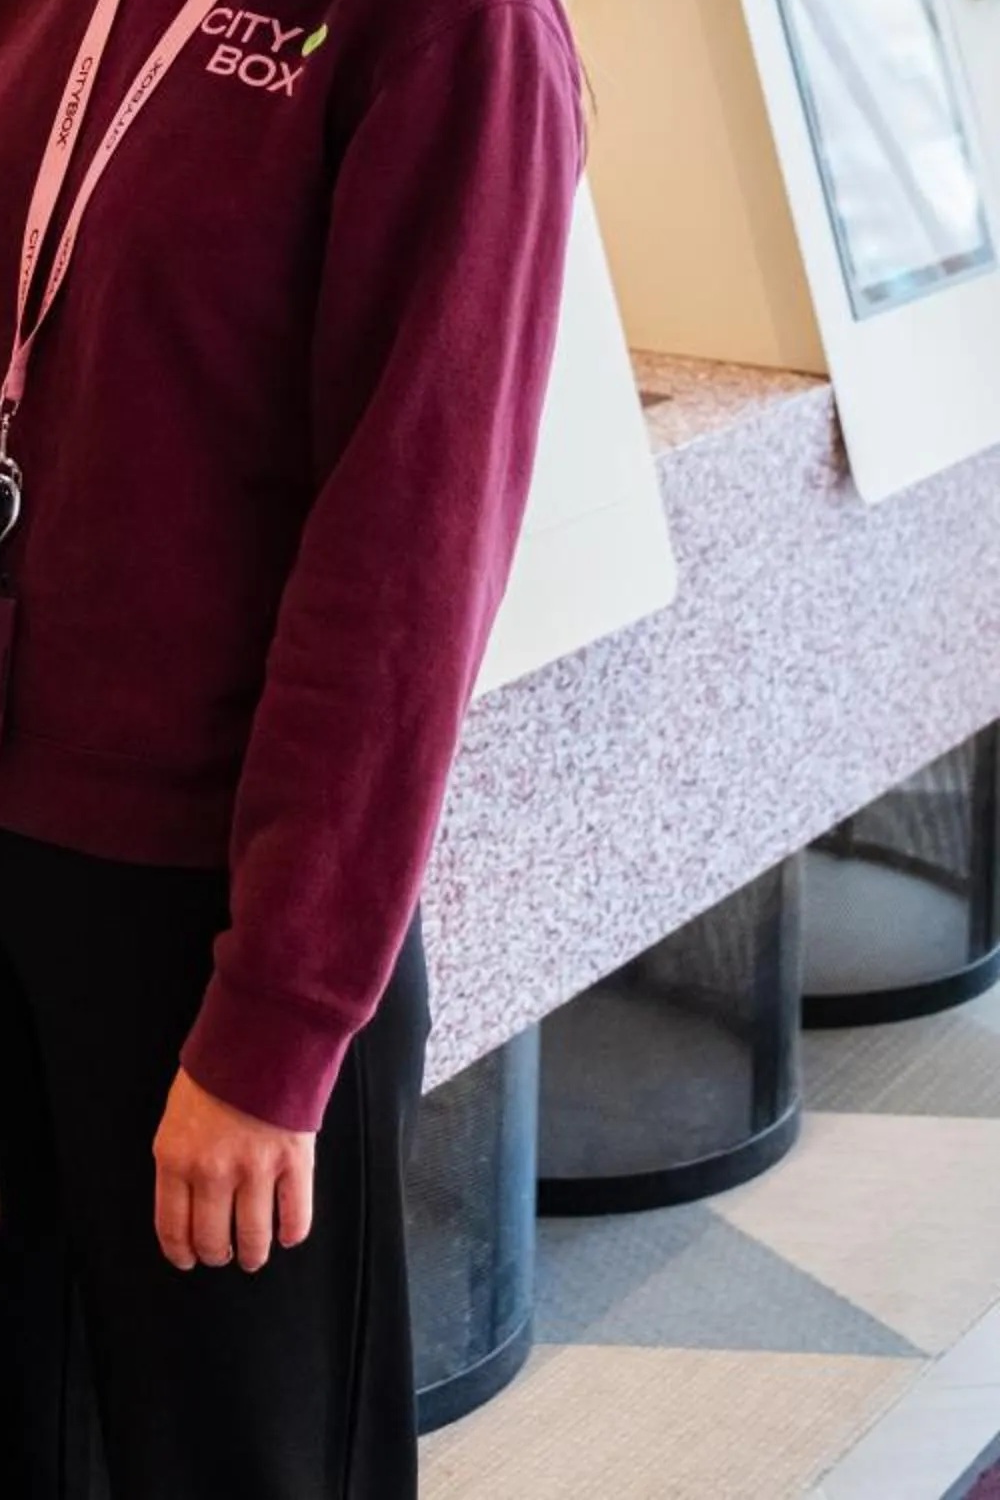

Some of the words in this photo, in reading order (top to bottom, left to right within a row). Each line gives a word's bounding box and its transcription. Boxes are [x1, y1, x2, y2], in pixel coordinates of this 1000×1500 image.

[200, 7, 304, 53] CITY
[205, 43, 304, 97] BOX
[56, 56, 93, 150] CITYBOX
